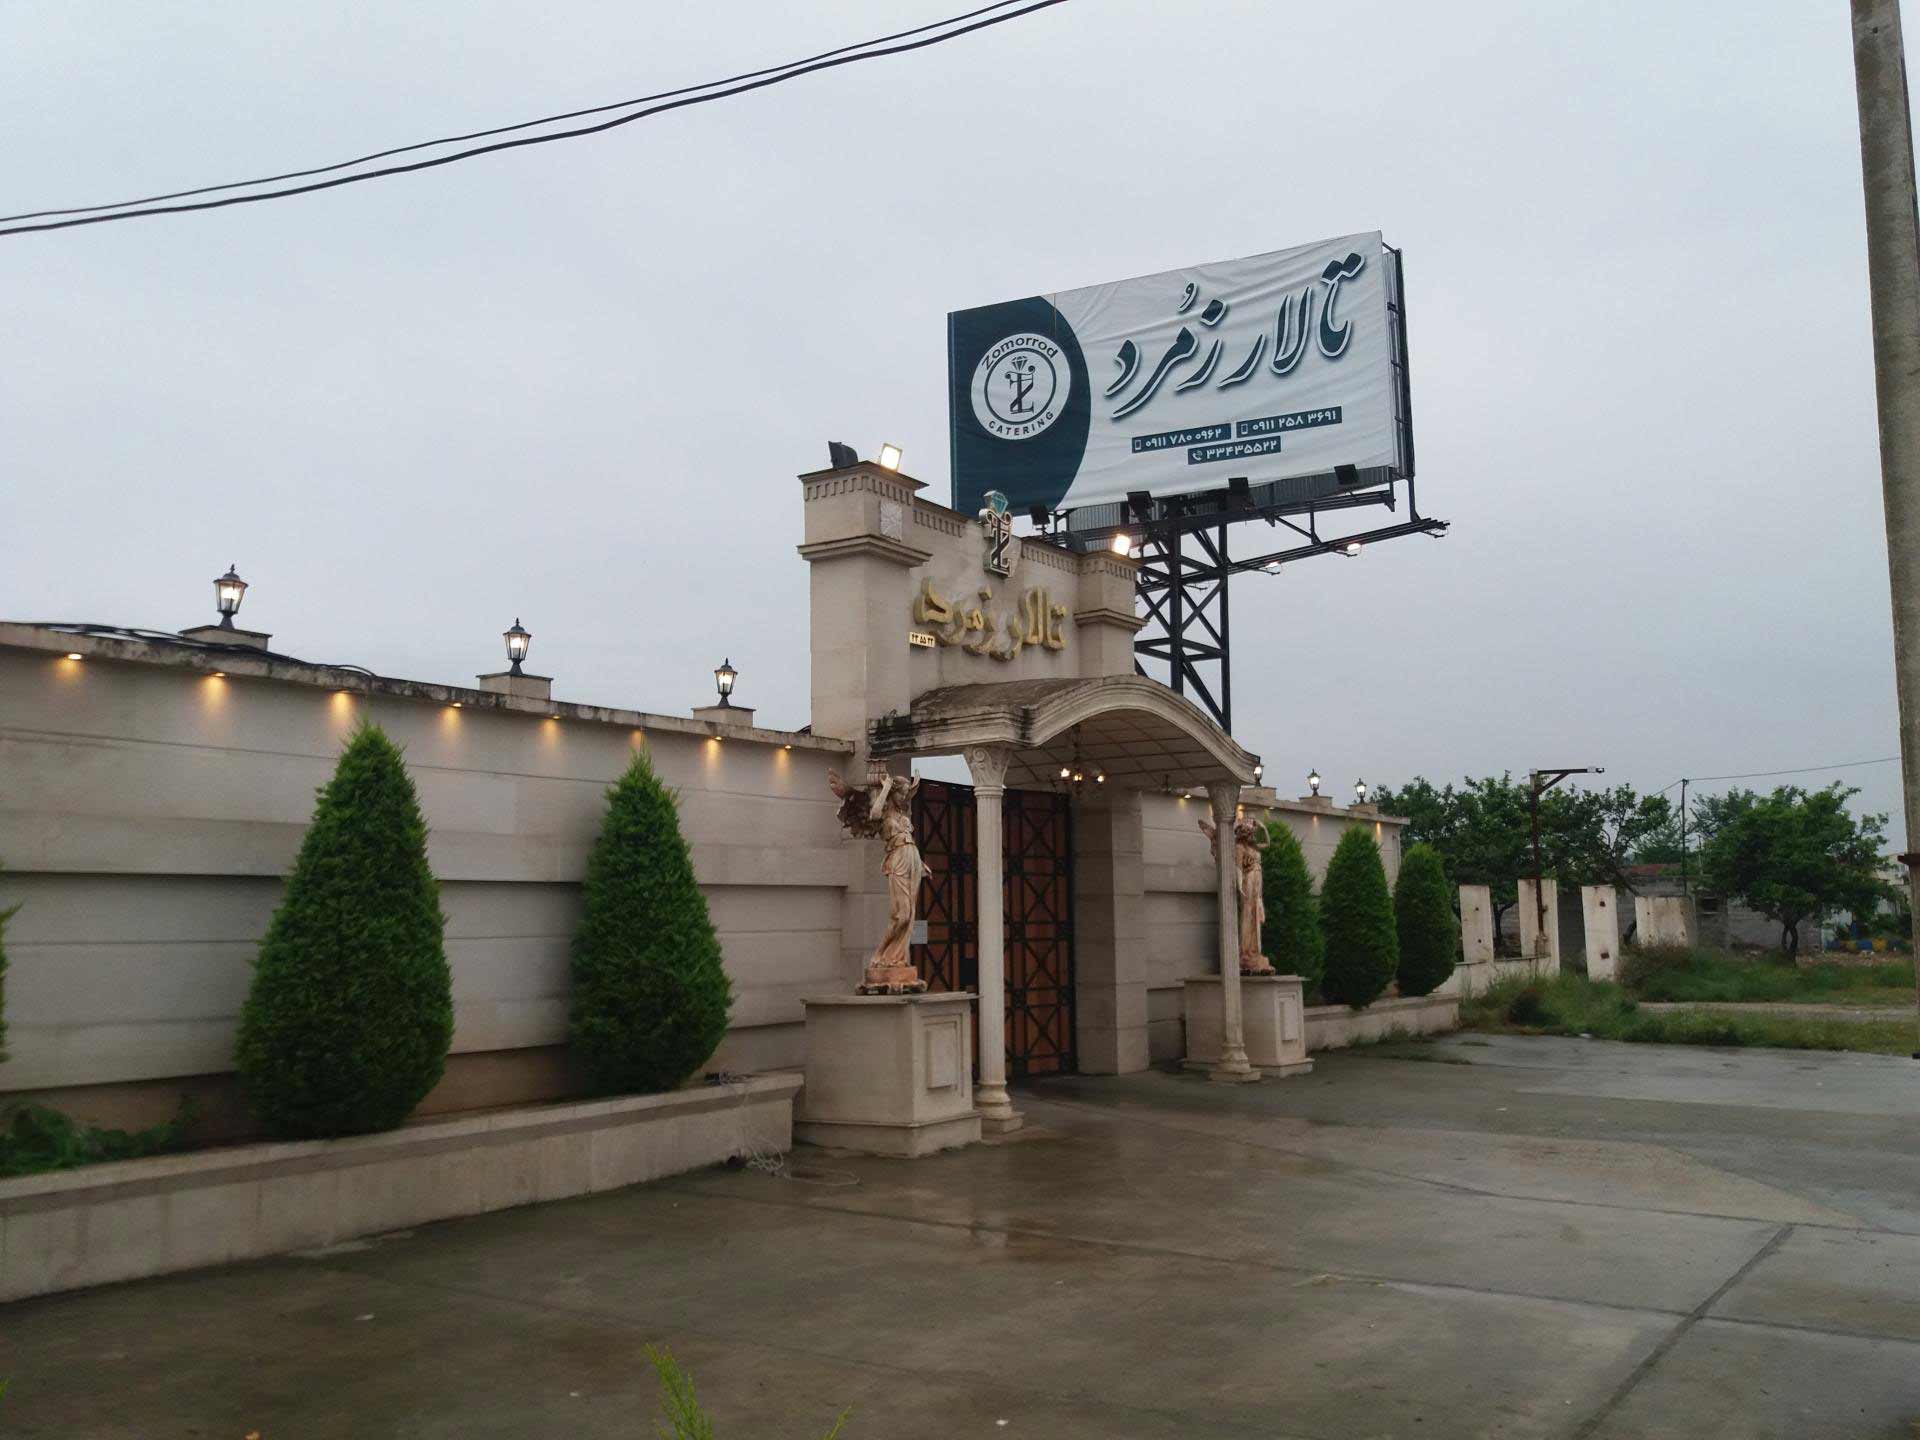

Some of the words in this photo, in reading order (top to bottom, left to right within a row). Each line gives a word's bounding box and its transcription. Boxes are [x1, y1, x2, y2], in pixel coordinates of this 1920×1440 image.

[1219, 252, 1366, 389] تالار
[988, 411, 1054, 436] CATERING
[1145, 437, 1167, 449] ۰۹۱۱
[1170, 434, 1192, 446] ۷۸۰
[1252, 418, 1275, 431] ۰۹۱۱
[1278, 416, 1304, 428] ۲۵۸
[913, 576, 994, 655] زمرد
[989, 586, 1067, 662] تالار
